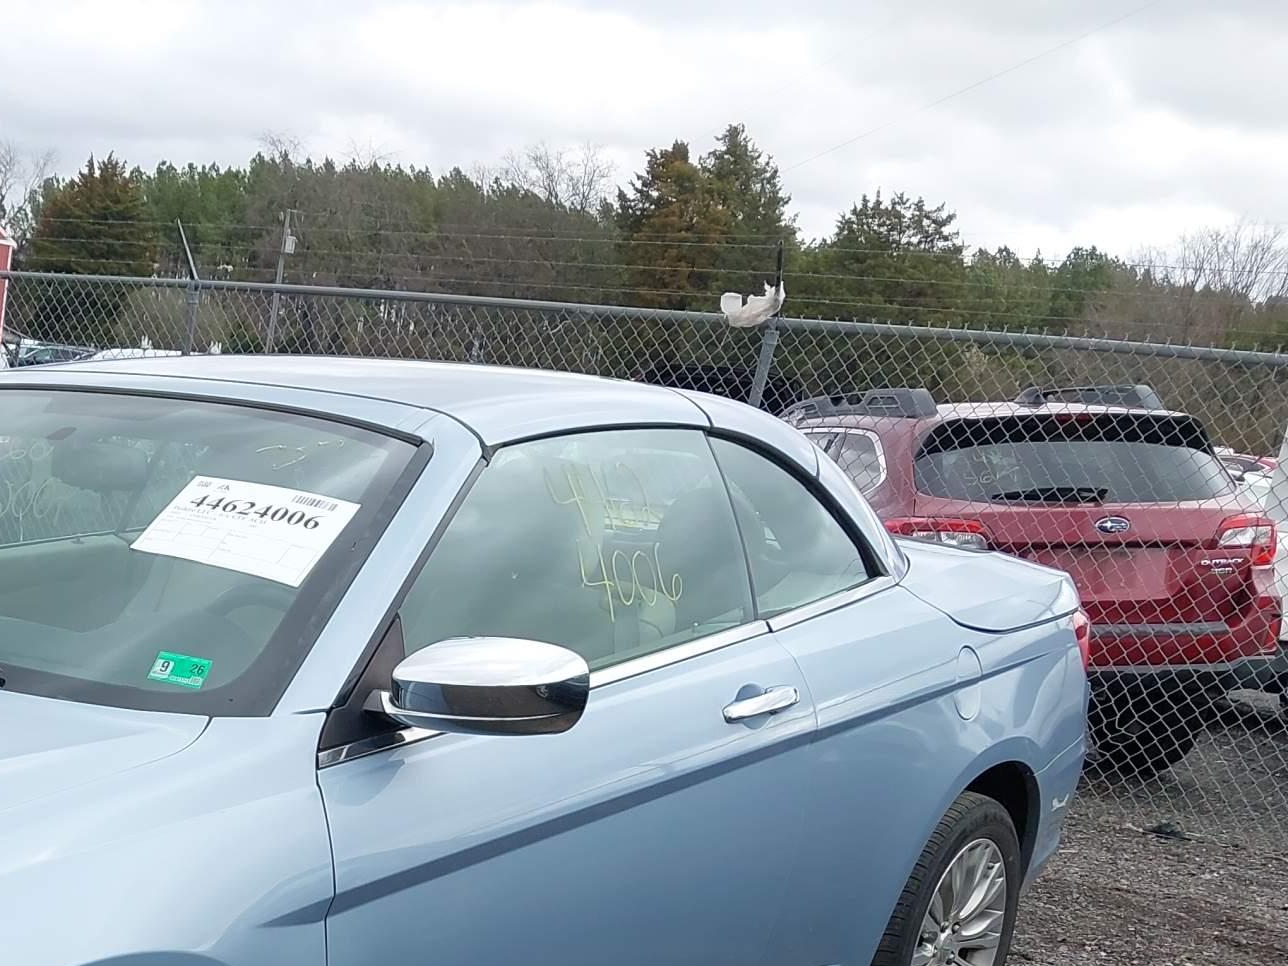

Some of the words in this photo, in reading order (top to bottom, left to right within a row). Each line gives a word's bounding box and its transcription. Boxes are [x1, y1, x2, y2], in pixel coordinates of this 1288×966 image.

[190, 494, 324, 530] 44624006
[575, 538, 683, 622] 4006
[160, 660, 171, 672] 9
[191, 663, 206, 676] 26
